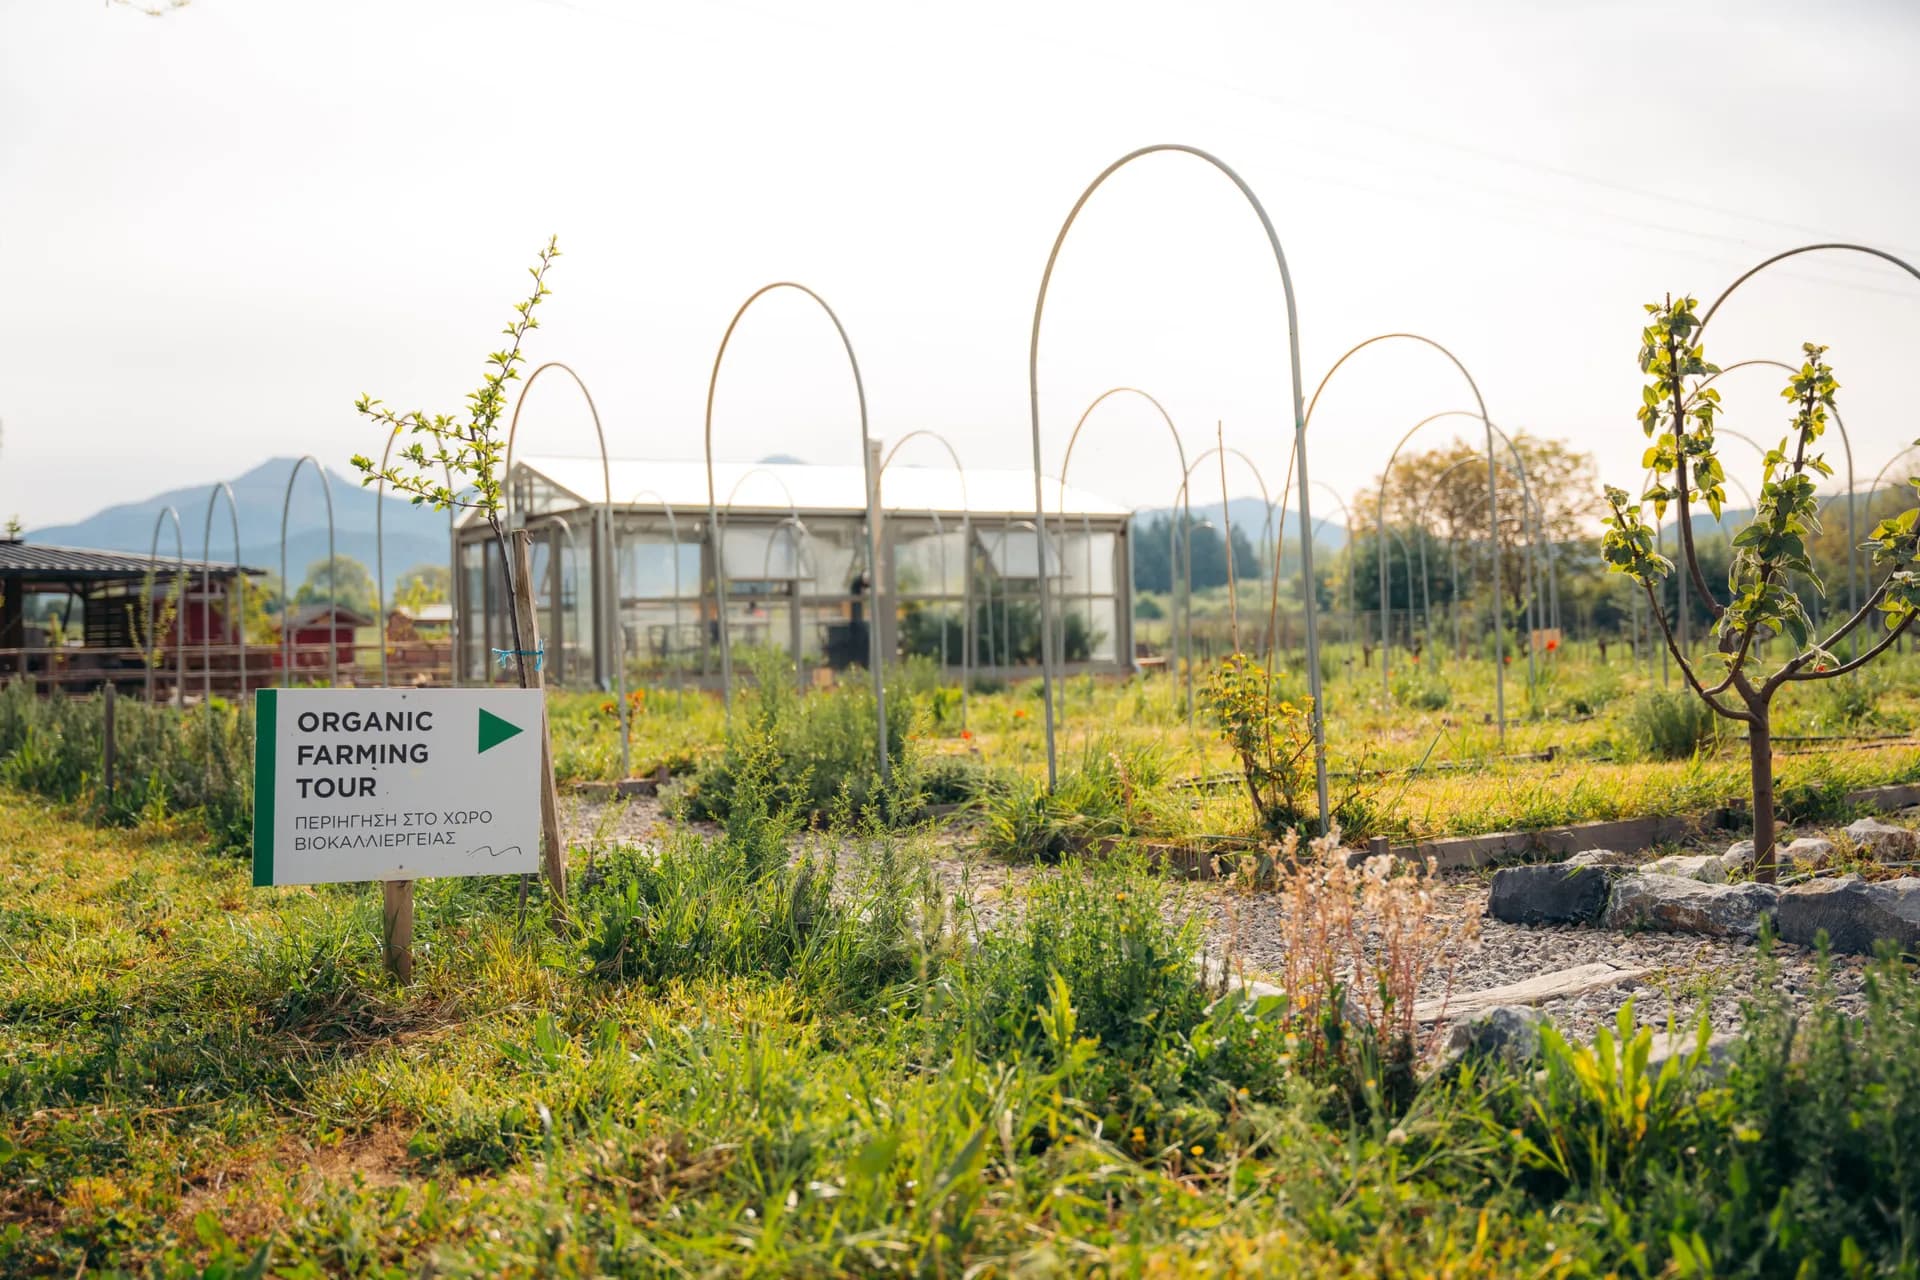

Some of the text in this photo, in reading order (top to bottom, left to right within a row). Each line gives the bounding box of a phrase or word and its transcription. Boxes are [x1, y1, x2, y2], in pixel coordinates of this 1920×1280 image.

[297, 711, 433, 732] ORGANIC
[297, 743, 429, 766] FARMING
[296, 777, 377, 799] TOUR
[295, 810, 492, 830] ΠΕΡΙΗΓΗΣΗ ΣΤΟ ΧΩΡΟ
[295, 831, 456, 851] ΒΙΟΚΑΛΛΙΕΡΓΕΙΑΣ
